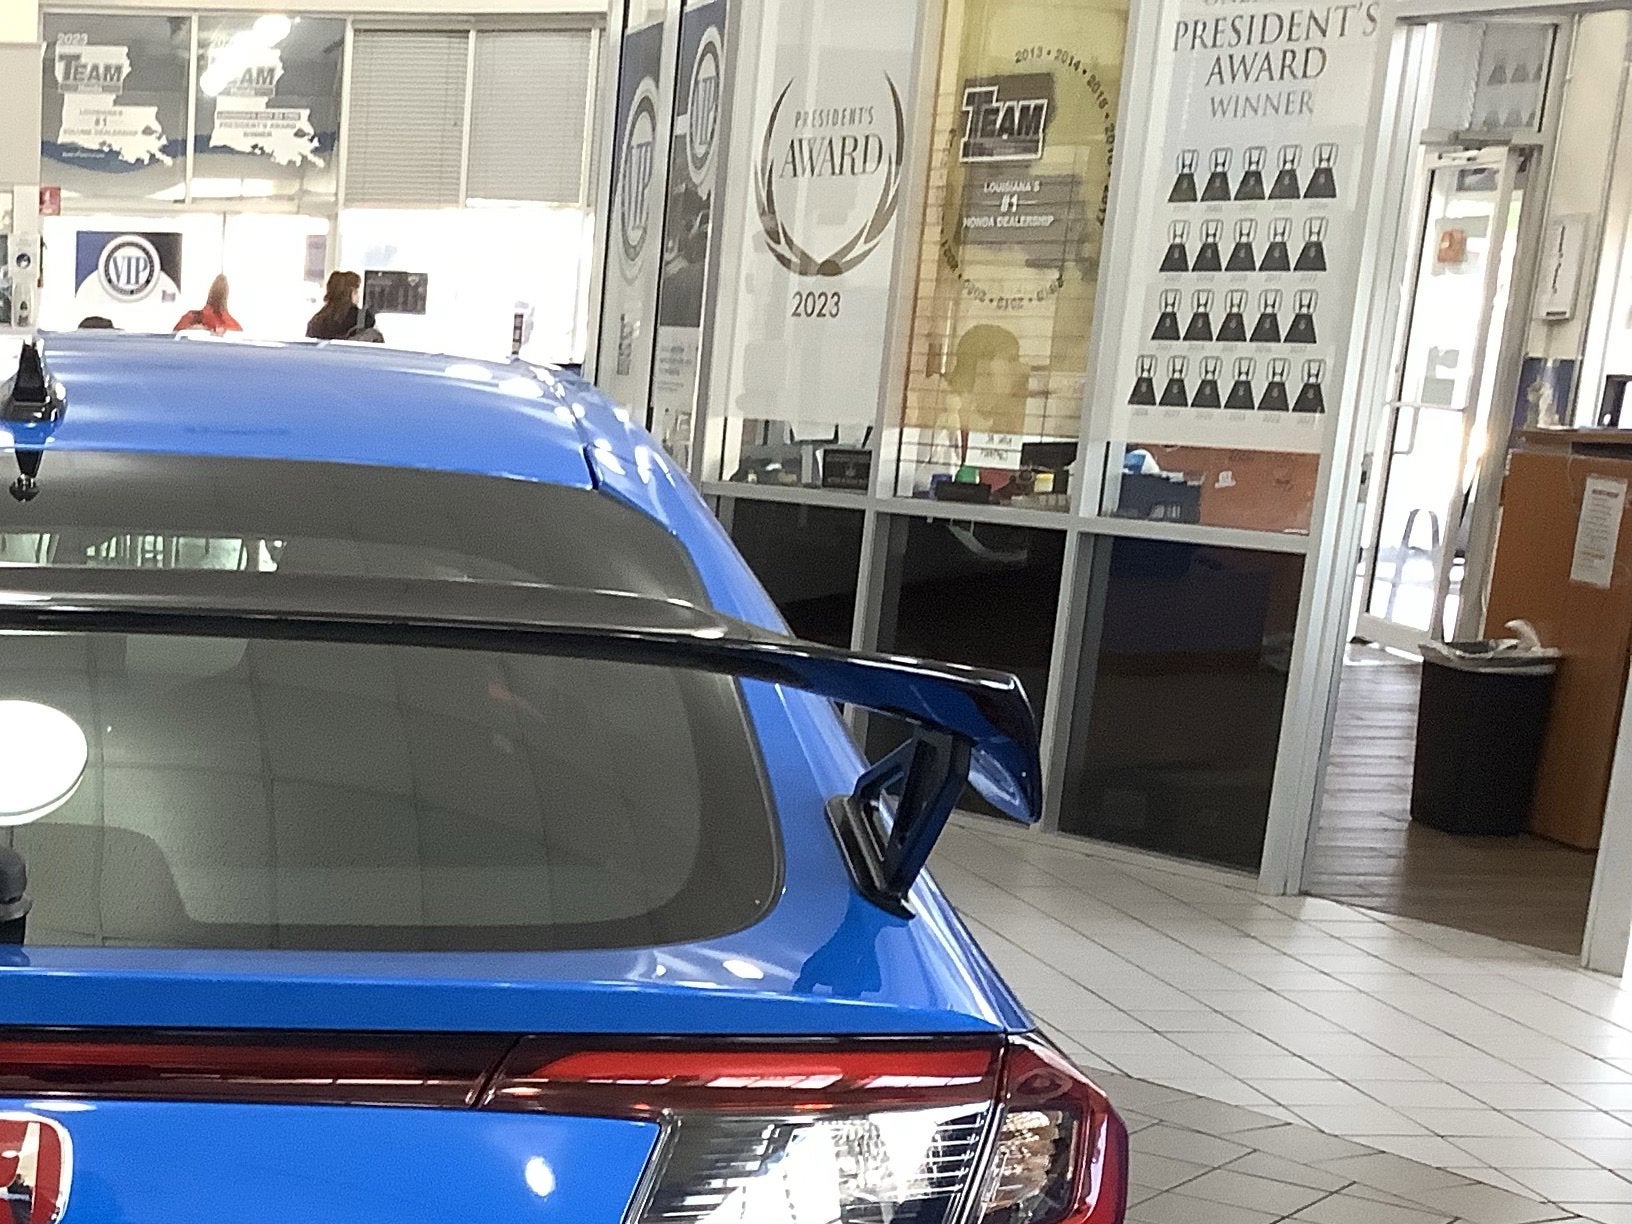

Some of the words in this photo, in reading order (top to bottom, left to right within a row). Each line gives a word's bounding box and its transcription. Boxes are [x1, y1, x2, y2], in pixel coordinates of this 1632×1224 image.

[1172, 1, 1380, 51] PRESIDENT'S
[58, 53, 123, 82] TEAM
[1054, 48, 1081, 72] 2014
[1205, 46, 1327, 86] AWARD
[795, 106, 874, 128] PRESIDENT'S
[963, 87, 1046, 141] TEAM
[1210, 89, 1314, 118] WINNER
[779, 133, 883, 178] AWARD
[1000, 194, 1018, 213] #1
[112, 255, 148, 285] VIP
[791, 290, 841, 318] 2023
